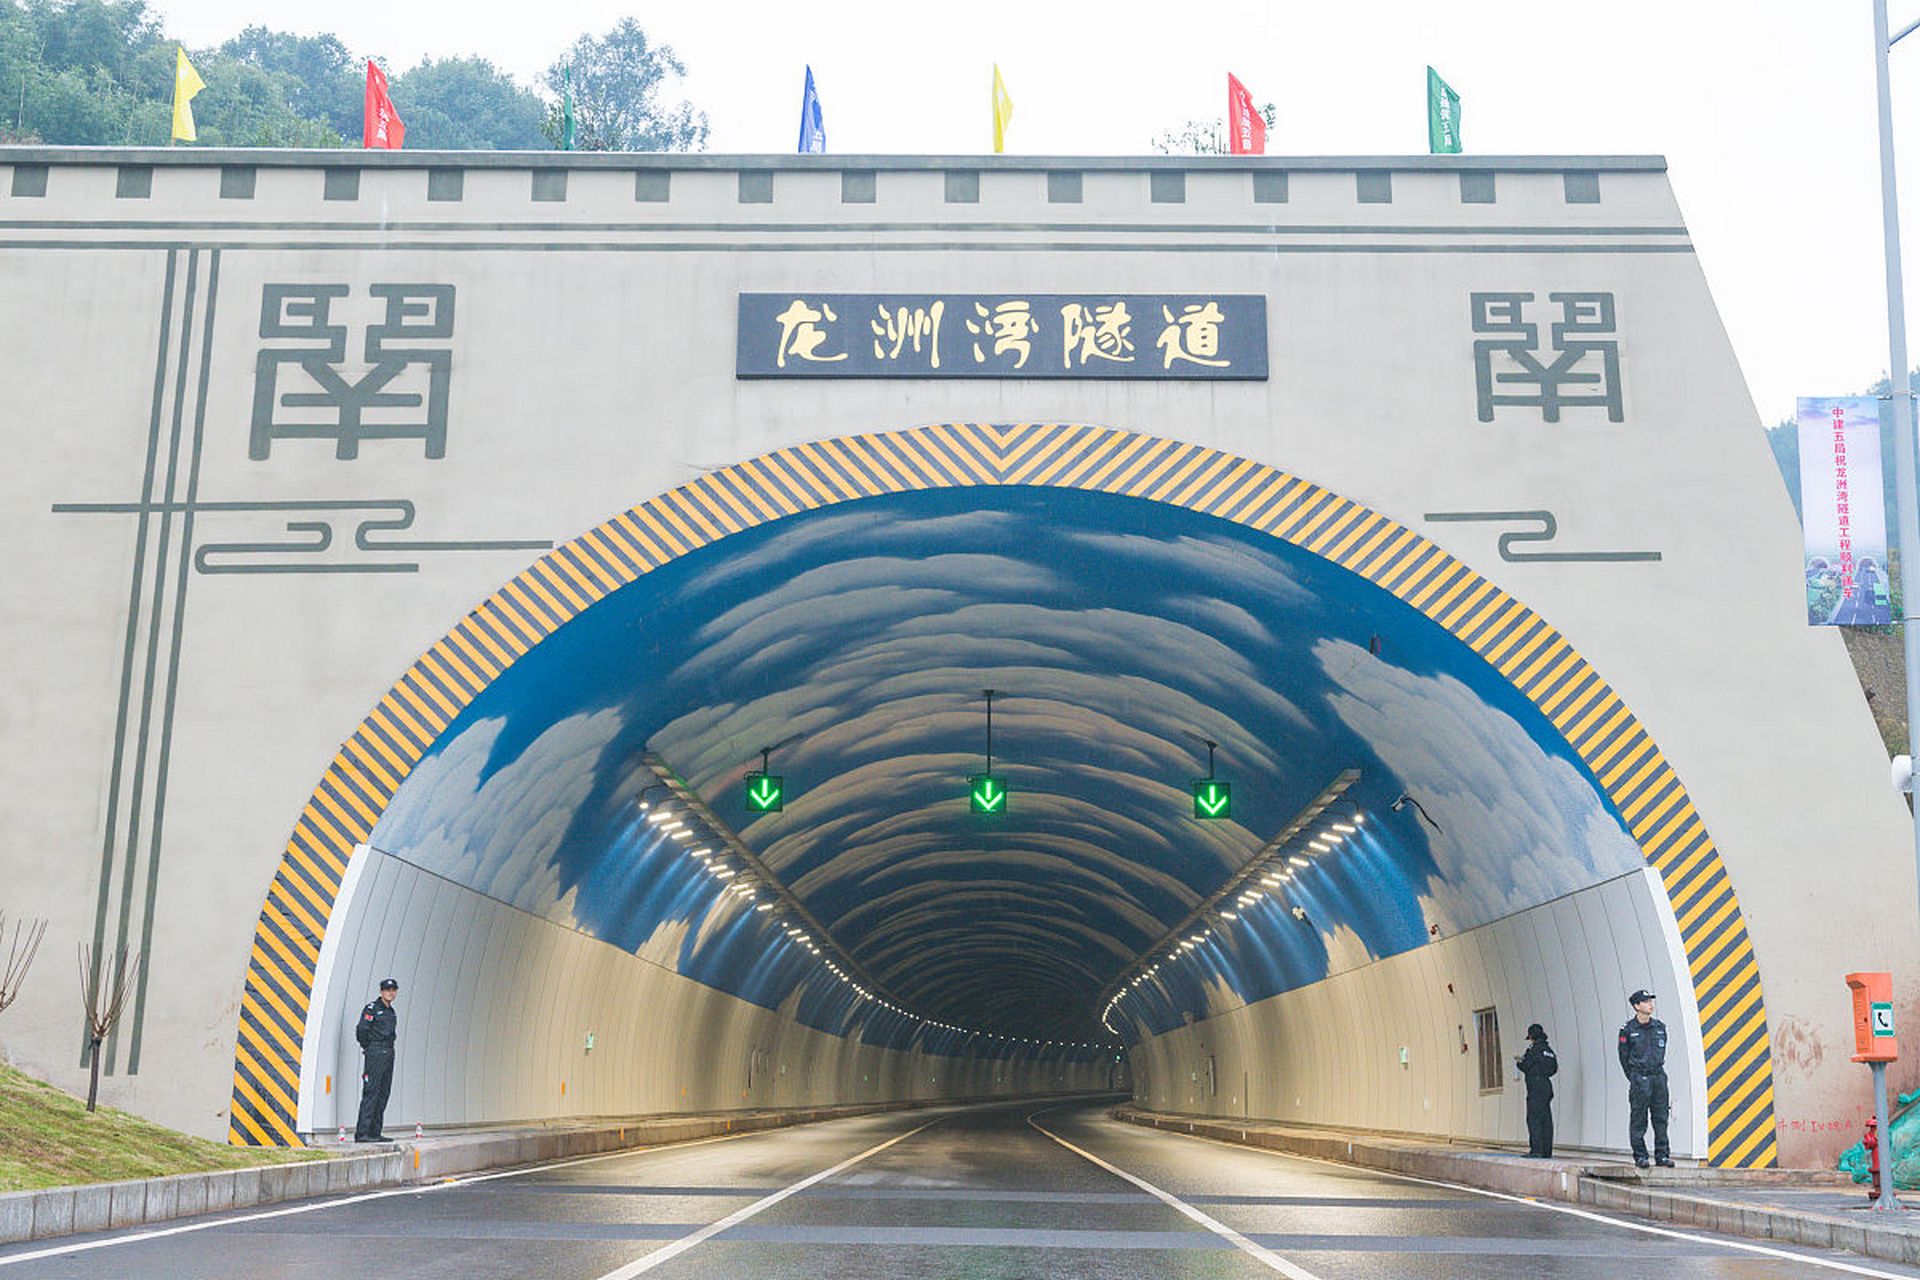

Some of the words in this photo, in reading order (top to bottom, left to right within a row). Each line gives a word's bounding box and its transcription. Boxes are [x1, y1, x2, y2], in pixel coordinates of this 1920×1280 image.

[776, 299, 1231, 369] 龙洲湾隧道
